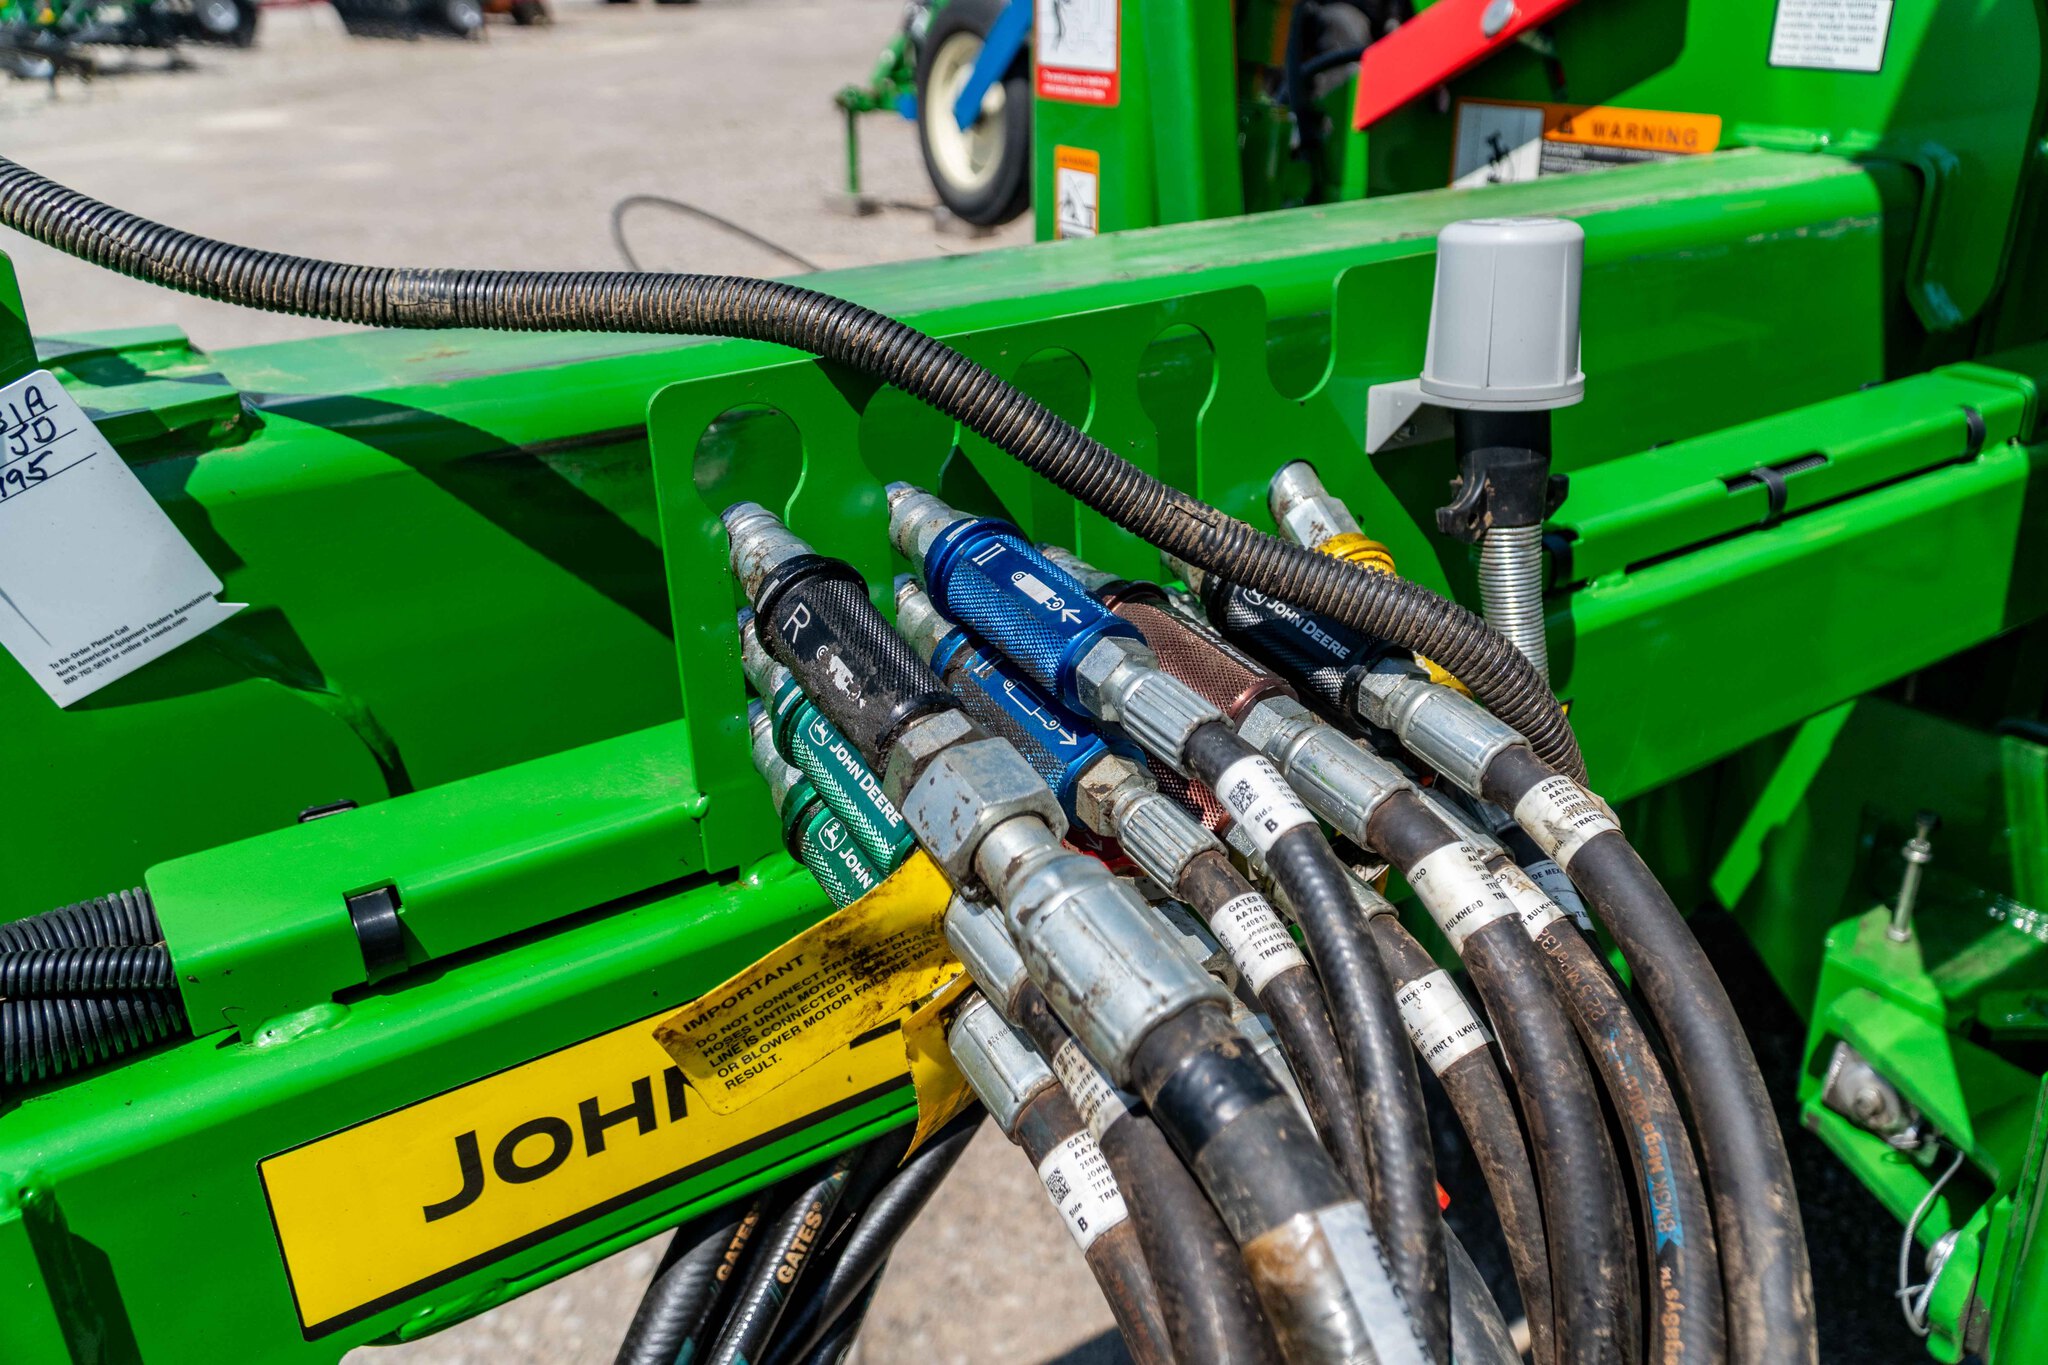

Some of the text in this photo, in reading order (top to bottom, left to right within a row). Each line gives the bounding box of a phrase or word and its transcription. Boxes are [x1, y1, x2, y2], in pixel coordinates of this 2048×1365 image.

[1591, 119, 1699, 148] WARNING
[8, 415, 57, 456] JD
[56, 590, 214, 678] North American Equipment Dealers Association
[112, 651, 121, 661] or
[121, 641, 143, 656] online
[142, 635, 152, 645] at
[150, 615, 190, 639] naeda.com
[782, 602, 811, 643] R
[1265, 599, 1351, 660] JOHN DEERE
[49, 624, 130, 671] To Re-Order Please Call
[1217, 643, 1268, 675] DEERE
[829, 742, 904, 829] JOHN DEERE
[1264, 818, 1279, 833] B
[838, 847, 875, 890] JOHN
[1531, 871, 1543, 880] DE
[1228, 895, 1258, 913] GATES
[1241, 914, 1268, 931] 240817
[683, 954, 804, 1033] IMPORTANT
[695, 1032, 719, 1049] DO
[720, 1013, 750, 1035] NOT
[753, 971, 820, 1016] CONNECT
[876, 930, 906, 949] LIFT
[702, 1024, 752, 1058] HOSES
[754, 1001, 797, 1028] UNTIL
[797, 970, 848, 1003] MOTOR
[891, 928, 938, 951] DRAIN
[709, 1044, 744, 1069] LINE
[745, 1034, 759, 1048] IS
[761, 983, 846, 1038] CONNECTED
[717, 1060, 740, 1078] OR
[741, 1024, 803, 1066] BLOWER
[803, 993, 853, 1029] MOTOR
[912, 943, 941, 962] MAY
[724, 1053, 783, 1091] RESULT.
[1077, 1070, 1098, 1092] DEERE
[1087, 1163, 1110, 1180] JOHN
[1069, 1202, 1083, 1218] Side
[1077, 1216, 1089, 1233] B
